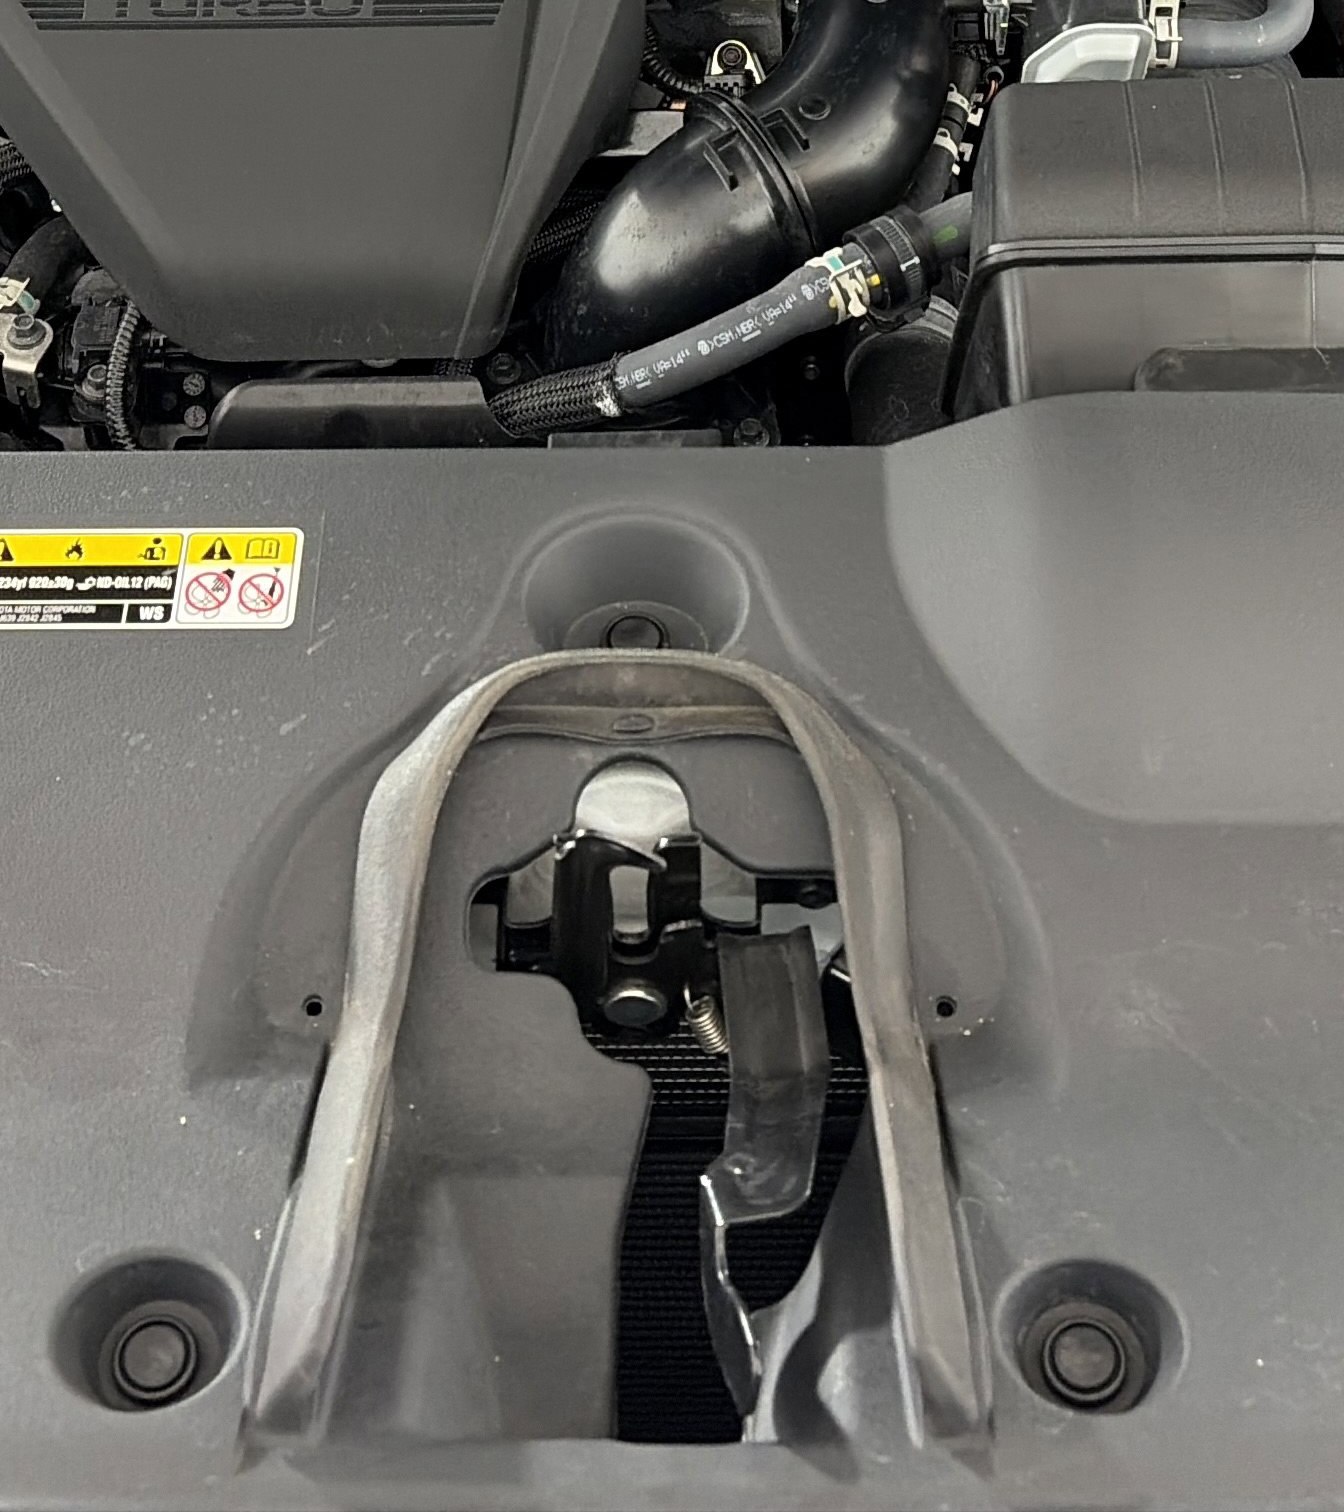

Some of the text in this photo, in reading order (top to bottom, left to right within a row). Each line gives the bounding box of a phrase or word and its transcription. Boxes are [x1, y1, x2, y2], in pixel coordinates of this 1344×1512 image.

[14, 605, 42, 614] MOTOR
[42, 605, 96, 614] CORPORATION
[139, 605, 165, 620] WS
